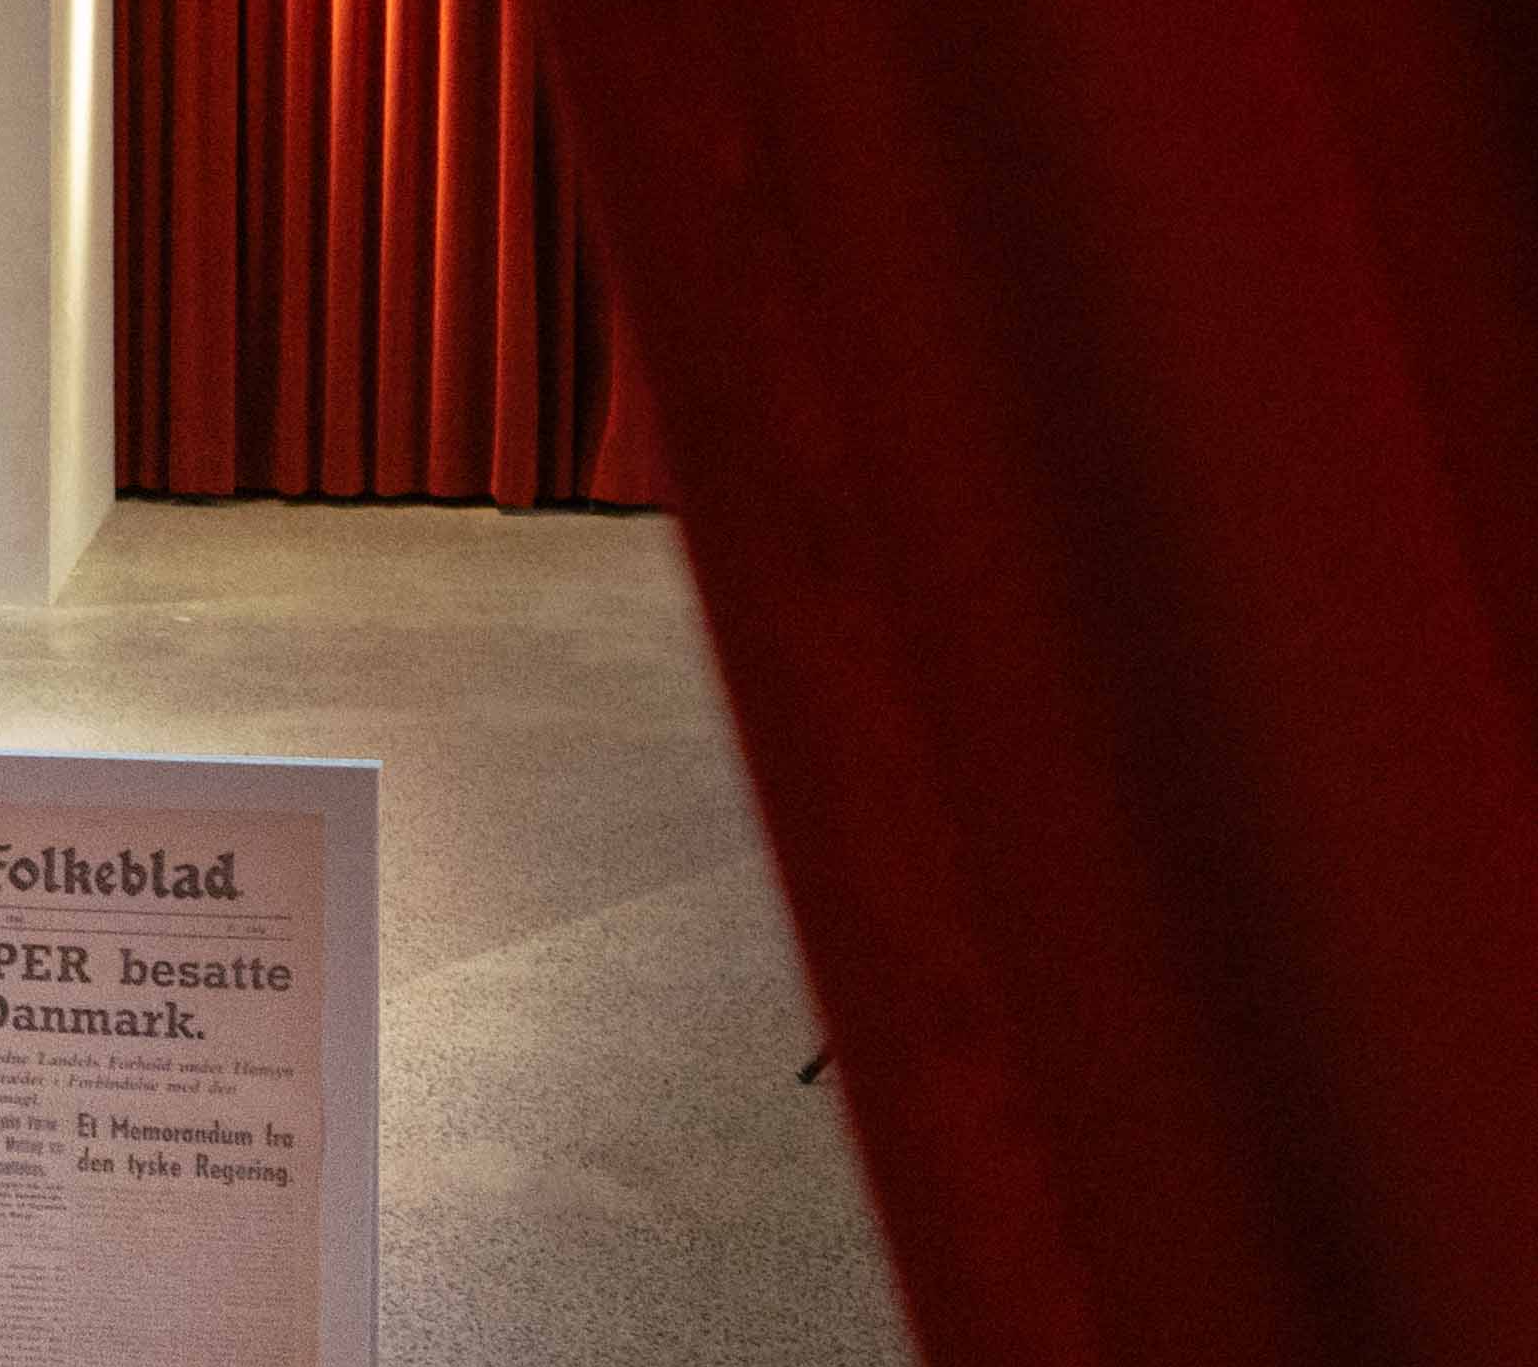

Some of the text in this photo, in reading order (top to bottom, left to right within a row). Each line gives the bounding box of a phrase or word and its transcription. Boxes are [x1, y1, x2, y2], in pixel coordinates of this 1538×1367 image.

[120, 947, 293, 992] besatte
[77, 1112, 294, 1148] Et Memorandum fra
[77, 1146, 294, 1188] den tyske Regering.
